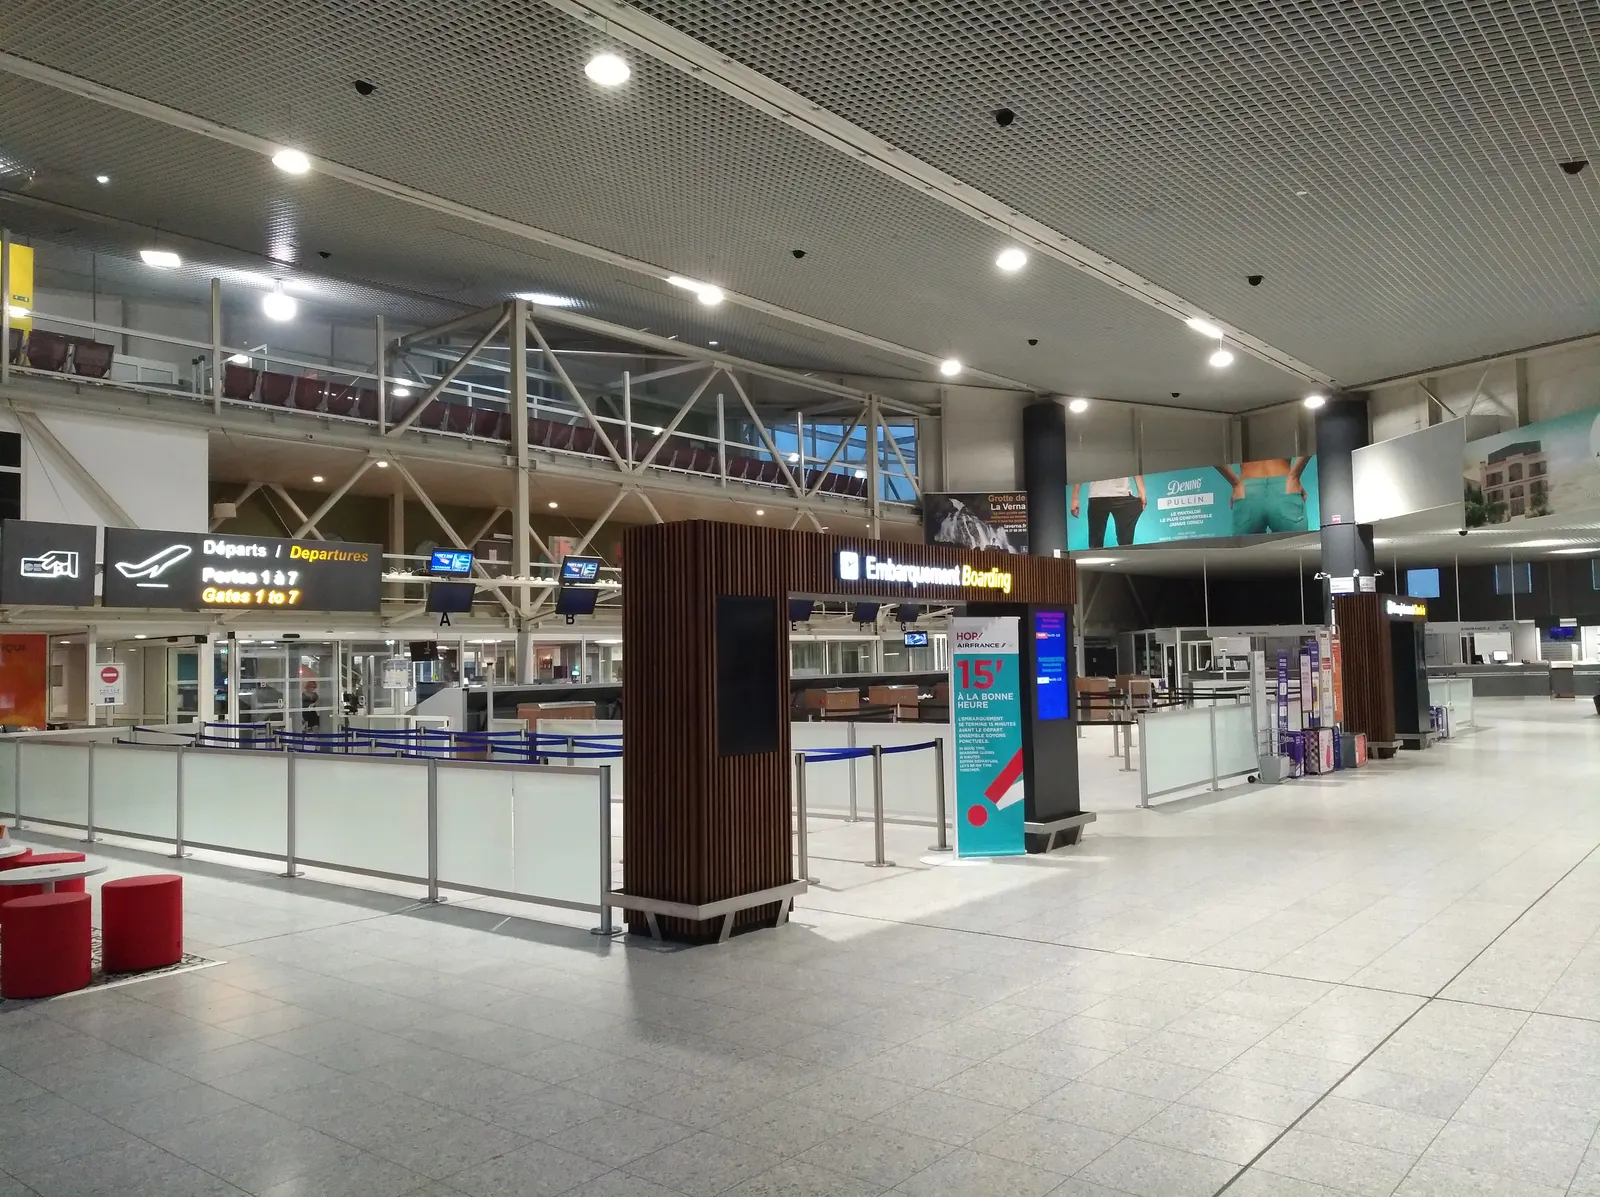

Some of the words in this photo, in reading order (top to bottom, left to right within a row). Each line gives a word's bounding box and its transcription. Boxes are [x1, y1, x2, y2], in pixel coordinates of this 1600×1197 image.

[988, 494, 1013, 502] Grotte
[1015, 494, 1026, 502] de
[1167, 496, 1204, 506] PULLIN
[990, 503, 1001, 511] La
[1002, 502, 1026, 510] Verna
[203, 540, 266, 558] Départs
[290, 545, 369, 562] Departures
[202, 567, 257, 584] Portes
[261, 569, 270, 584] 1
[274, 569, 285, 585] à
[288, 571, 299, 585] 7
[866, 556, 960, 588] Embarquement
[962, 565, 1011, 593] Boarding
[202, 587, 251, 603] Gates
[255, 589, 265, 603] 1
[267, 590, 285, 604] to
[289, 590, 300, 604] 7
[439, 612, 450, 626] A
[565, 613, 575, 624] B
[791, 621, 797, 631] E
[901, 621, 906, 632] G
[956, 659, 1004, 690] 15'
[957, 692, 963, 700] À
[981, 692, 1013, 700] BONNE
[957, 701, 989, 709] HEURE
